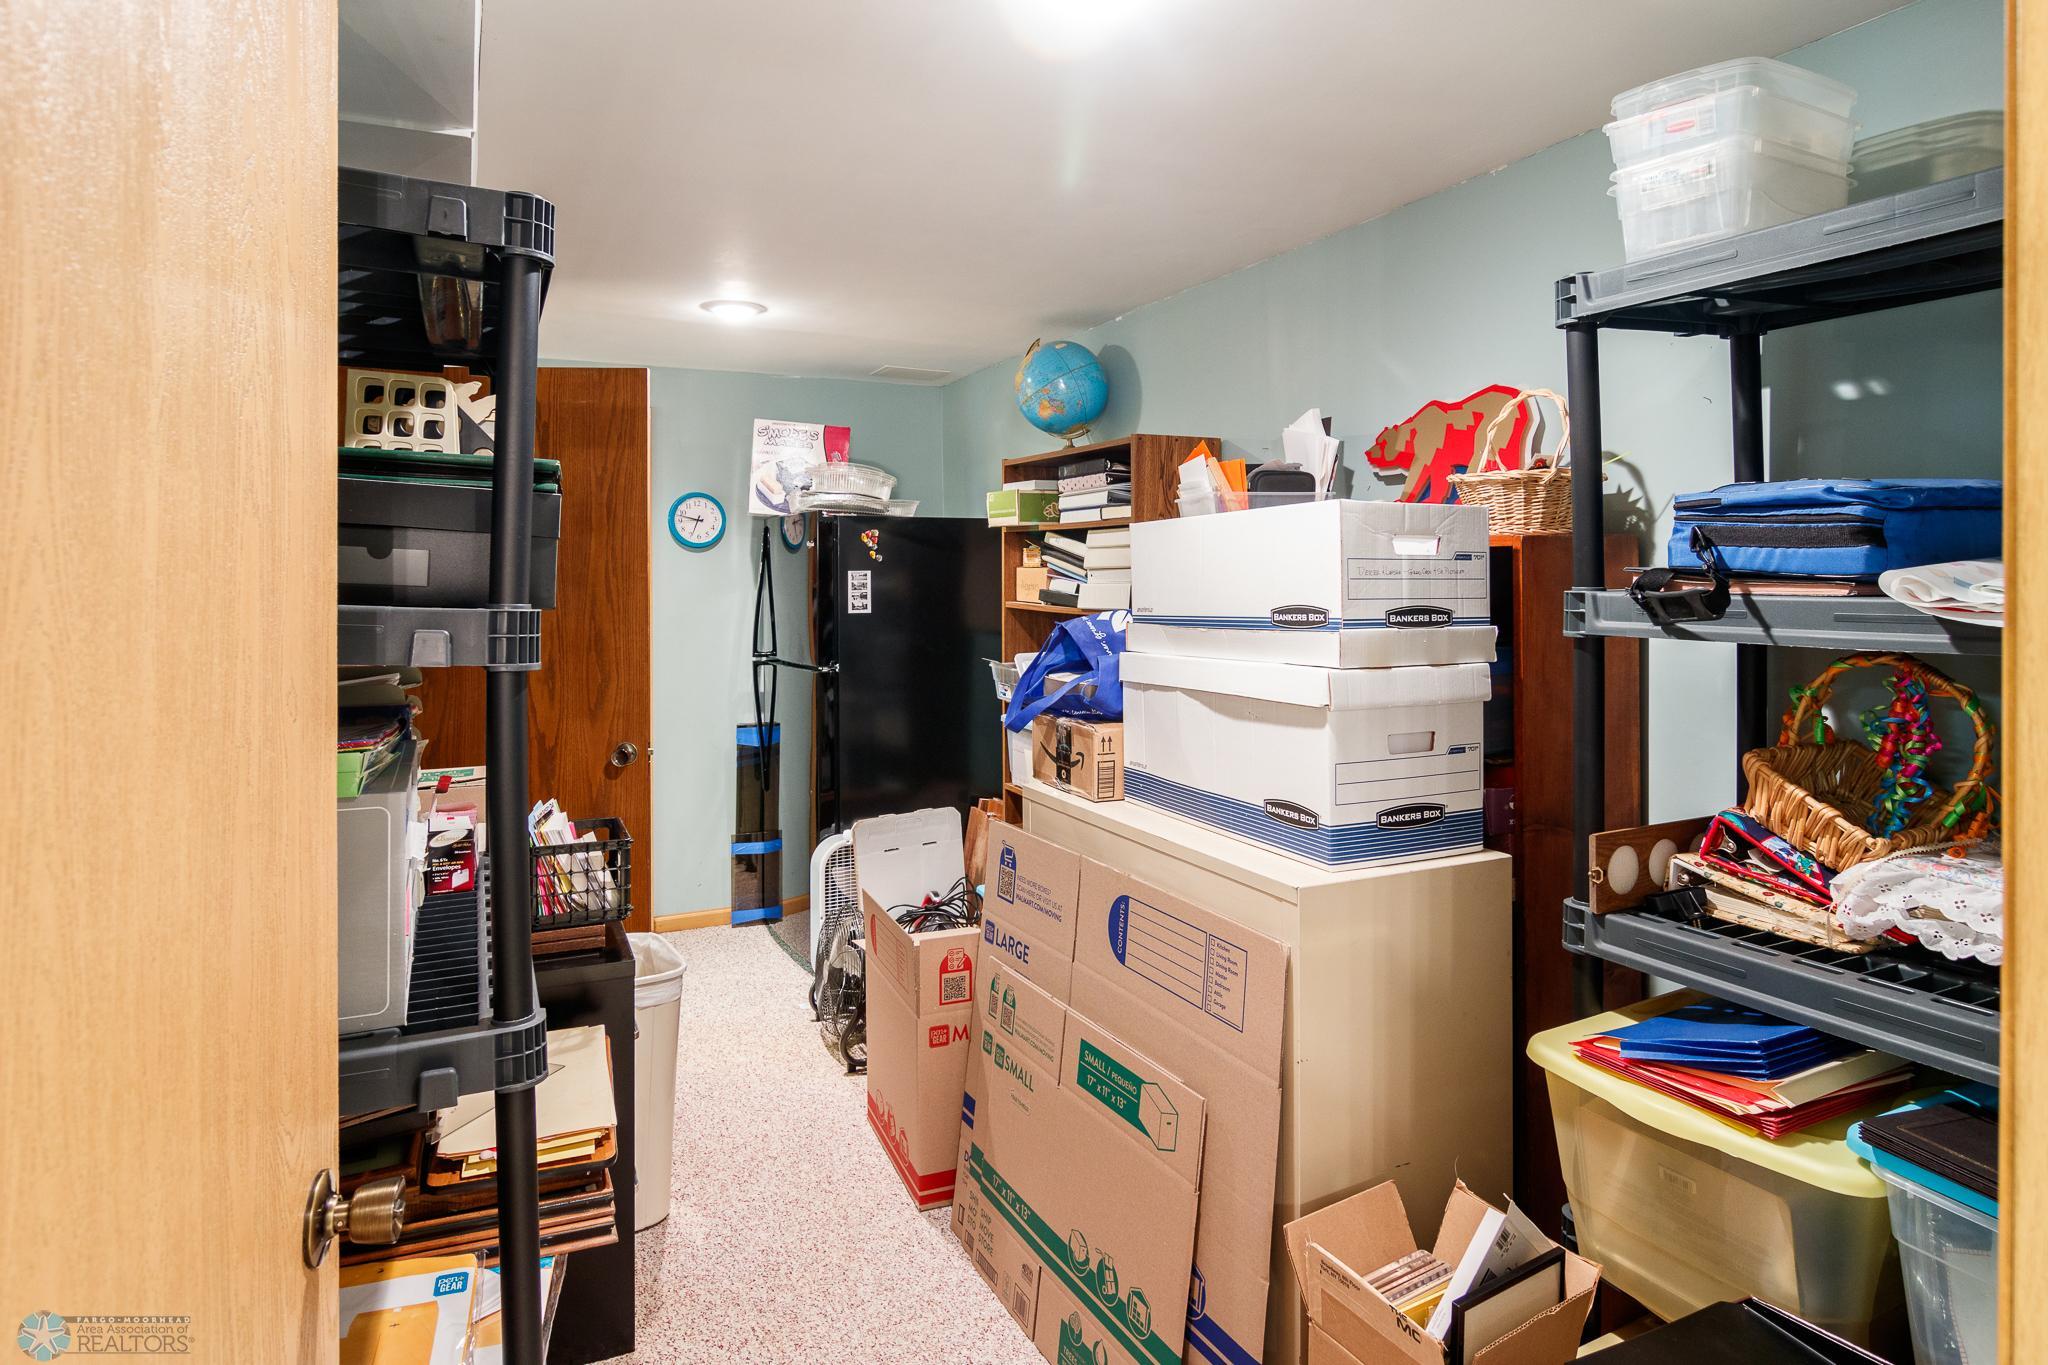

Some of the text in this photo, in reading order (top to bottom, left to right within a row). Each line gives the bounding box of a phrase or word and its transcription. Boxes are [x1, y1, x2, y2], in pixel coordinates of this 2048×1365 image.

[1273, 613, 1325, 622] BANKERS BOX
[1389, 614, 1430, 623] BANKERS
[1266, 805, 1316, 825] BANKERS BOX
[1380, 809, 1441, 824] BANKERS BOX
[995, 928, 1030, 964] LARGE
[1216, 943, 1230, 954] Kitchen
[1216, 952, 1238, 967] Living Room
[1215, 962, 1239, 977] Dining Room
[1215, 971, 1227, 981] Master
[1214, 980, 1231, 993] Bedroom
[1213, 998, 1226, 1010] Garage
[1005, 1055, 1034, 1093] SMALL
[1084, 1050, 1106, 1074] SMALL
[1111, 1071, 1138, 1095] PEQUEÑO
[1111, 1095, 1116, 1103] x
[981, 1208, 992, 1226] SHIP
[980, 1223, 994, 1243] MOVE
[978, 1233, 994, 1257] STORE
[439, 1281, 463, 1293] GEAR
[1396, 1317, 1421, 1344] MC
